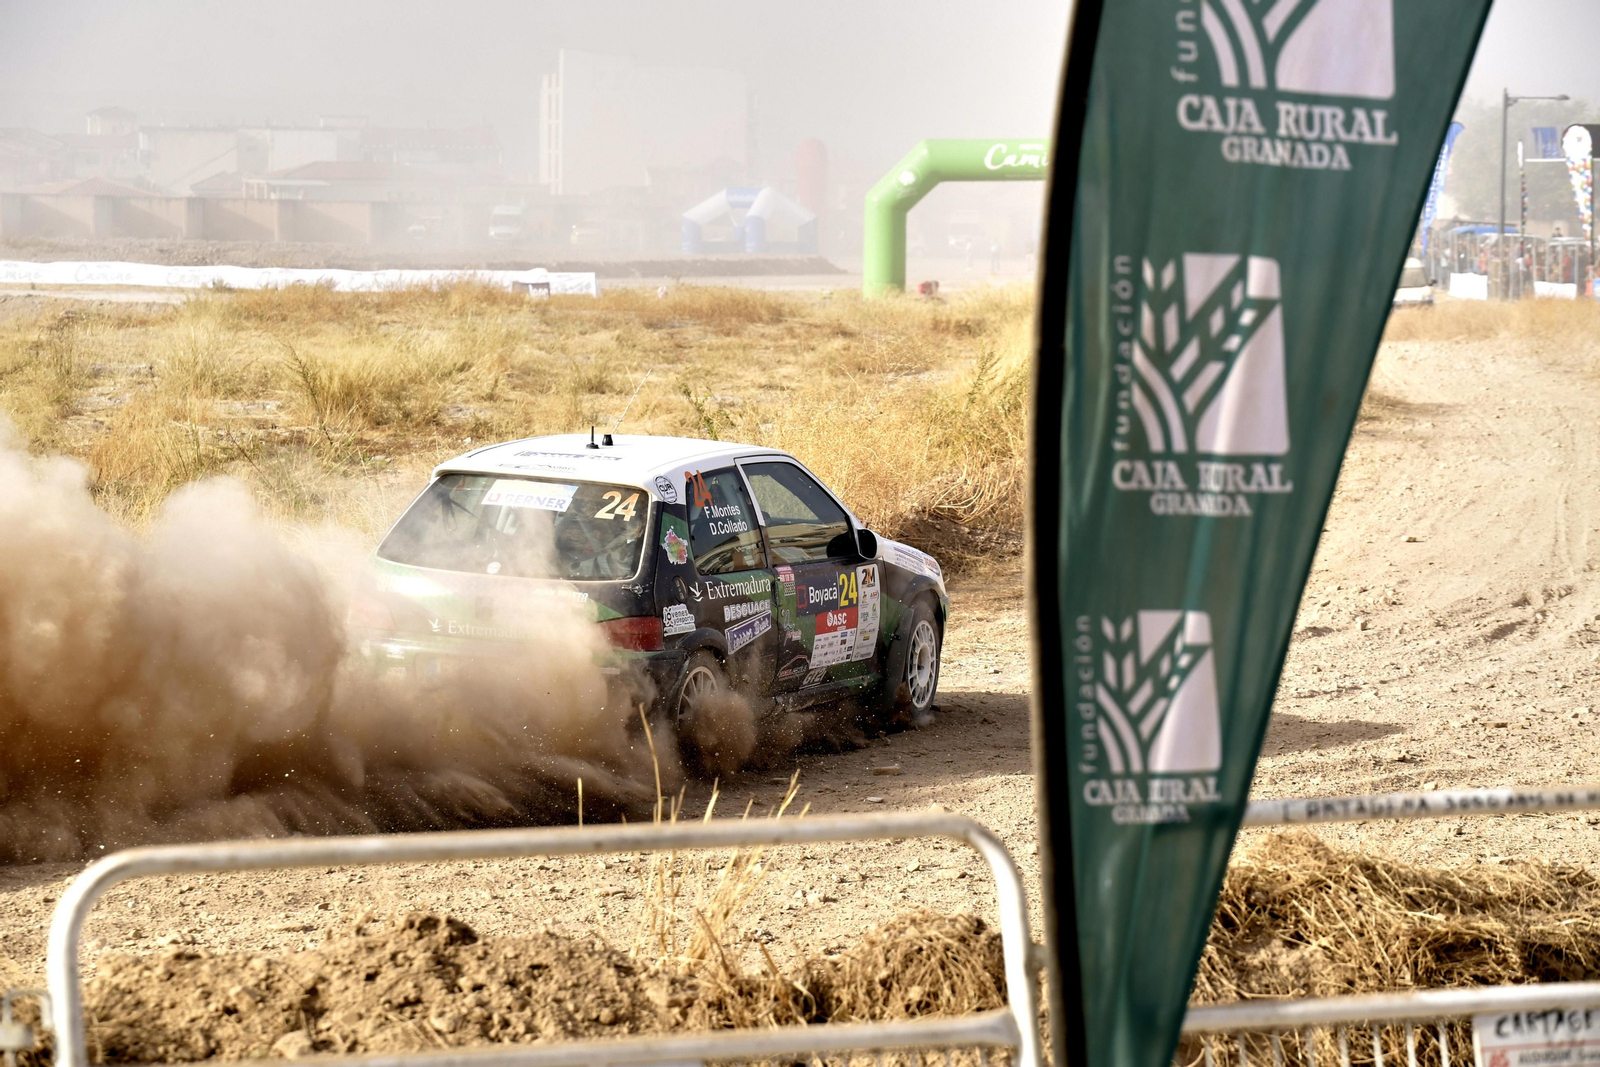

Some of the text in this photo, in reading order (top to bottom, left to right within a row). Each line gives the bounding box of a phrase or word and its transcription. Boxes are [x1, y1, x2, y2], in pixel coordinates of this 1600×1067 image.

[1170, 0, 1198, 83] fun
[1177, 94, 1398, 146] CAJA RURAL
[984, 143, 1050, 170] Cami
[1221, 135, 1352, 171] GRANADA
[685, 470, 712, 508] 24
[1112, 460, 1187, 491] CAJA
[594, 490, 640, 522] 24
[704, 504, 741, 519] F.Montes
[709, 518, 748, 536] D.Collado
[705, 575, 771, 600] Extremadura
[809, 583, 838, 606] Boyacá
[840, 572, 858, 607] 24
[723, 600, 771, 623] DESGUACE
[833, 612, 847, 626] ASC
[448, 620, 530, 639] Extremad
